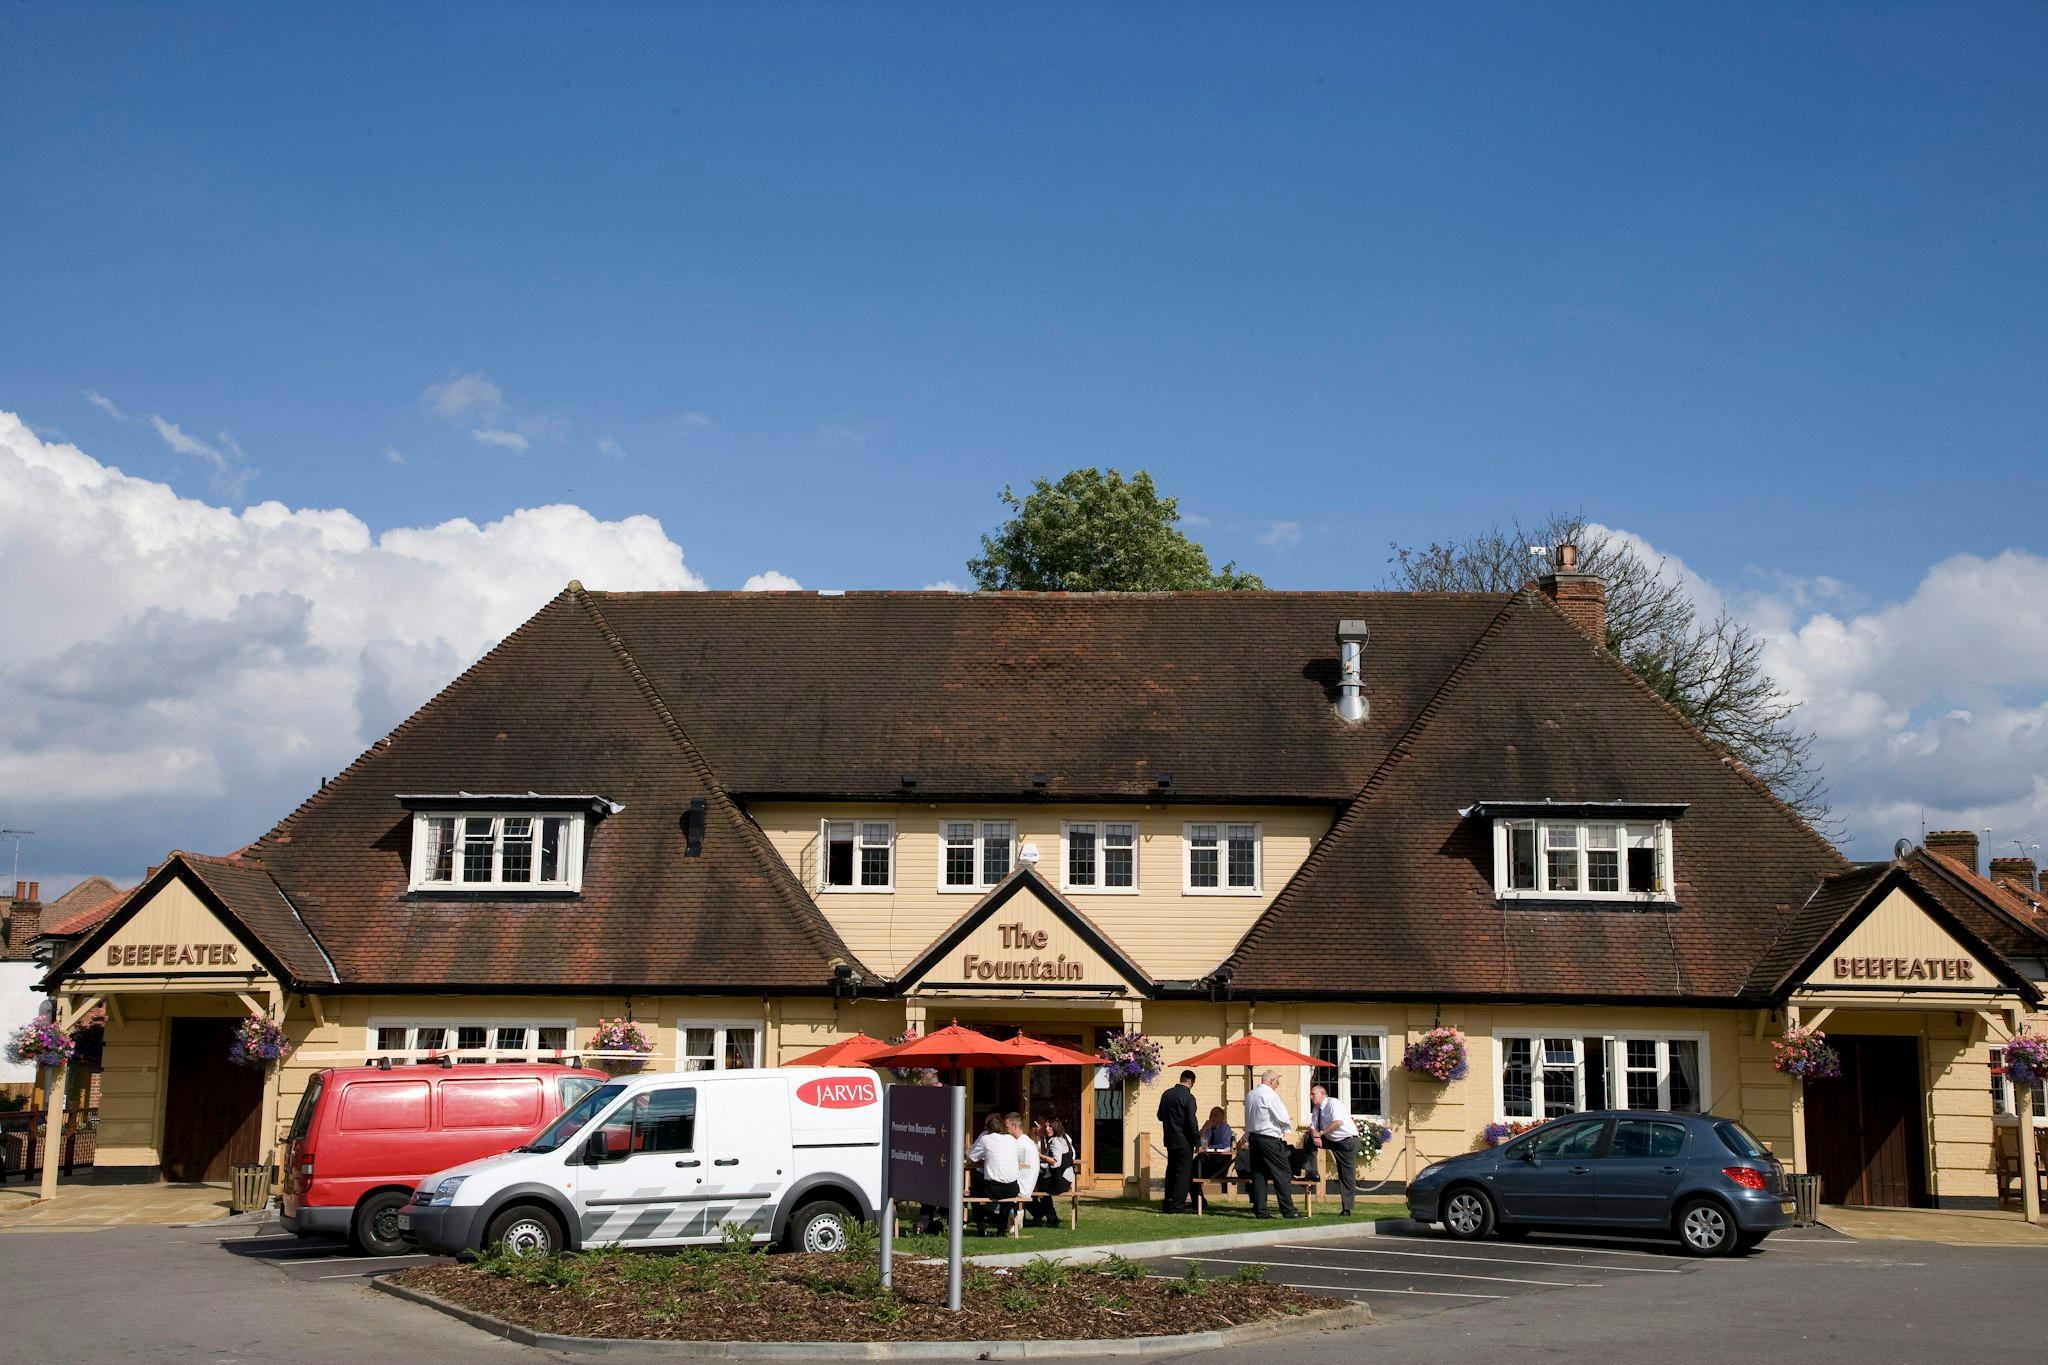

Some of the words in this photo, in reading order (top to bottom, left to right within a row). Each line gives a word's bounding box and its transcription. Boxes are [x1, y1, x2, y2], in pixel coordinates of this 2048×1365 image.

[998, 922, 1048, 950] The
[107, 944, 238, 966] BEEFEATER
[964, 953, 1083, 981] Fountain
[1834, 957, 1975, 981] BEEFEATER
[816, 1084, 875, 1107] JARVIS
[892, 1121, 907, 1131] Premier
[916, 1123, 936, 1136] Reception
[891, 1149, 907, 1160] Disabled
[908, 1150, 923, 1165] Parking
